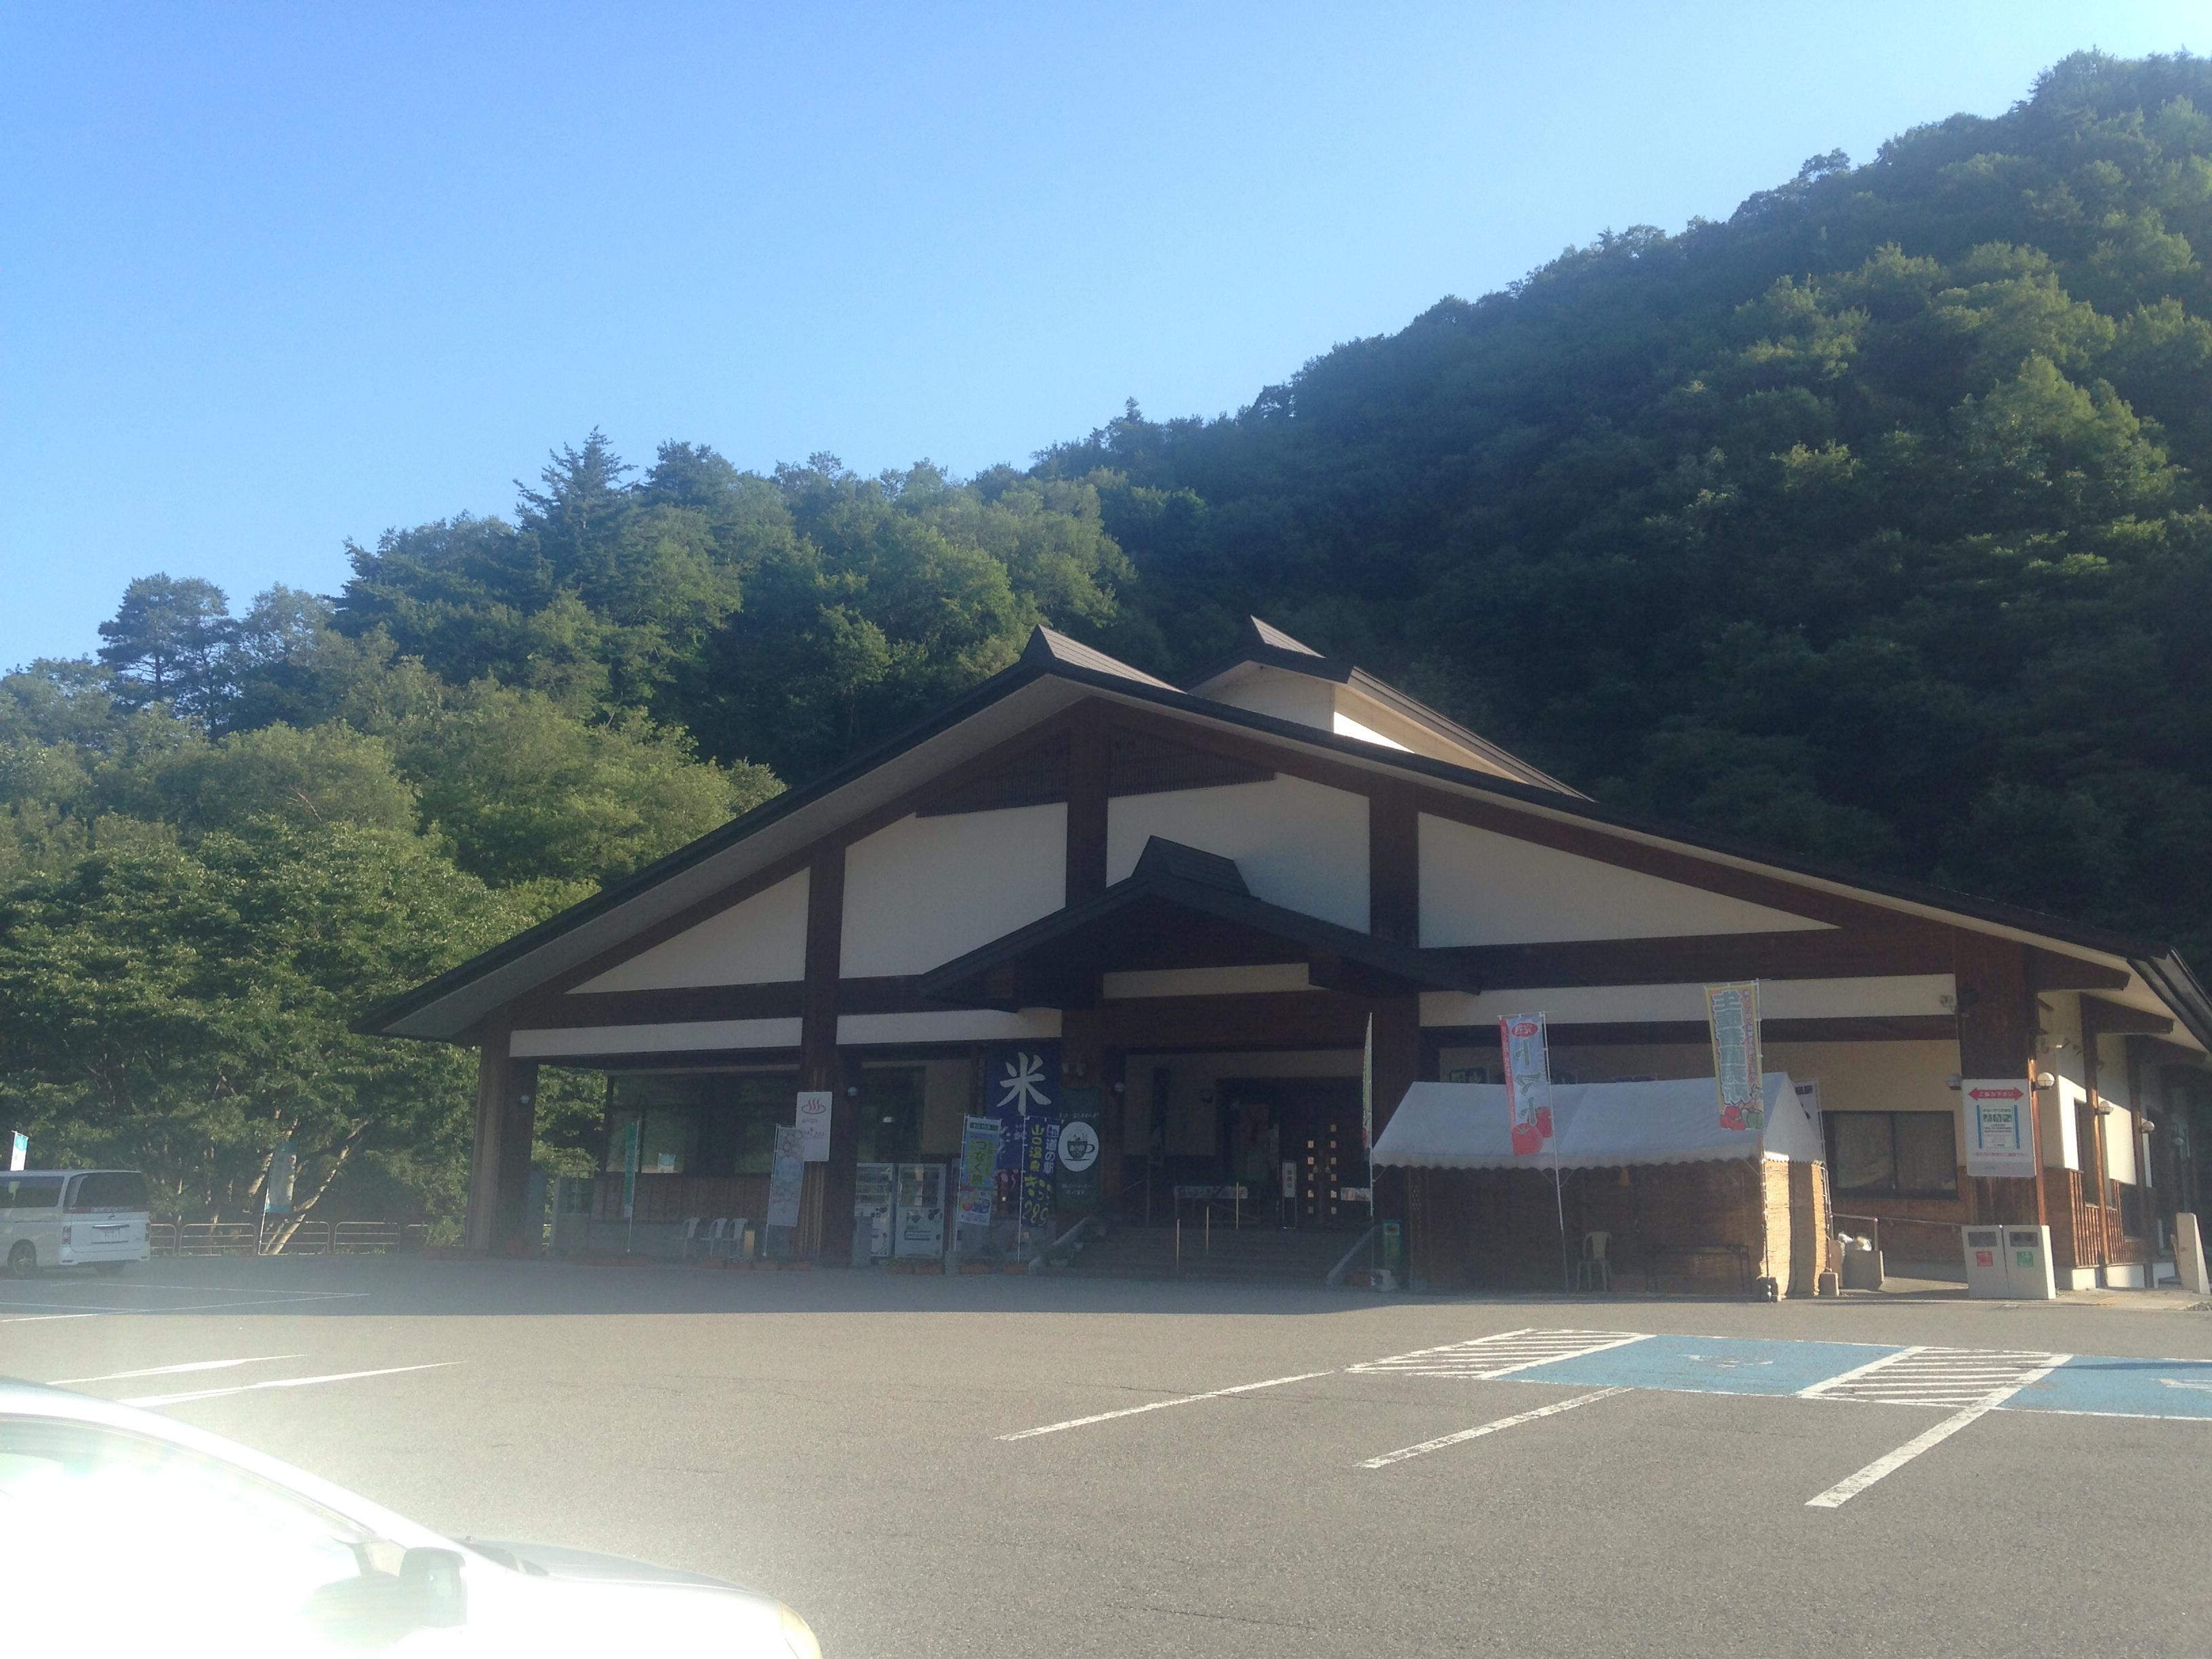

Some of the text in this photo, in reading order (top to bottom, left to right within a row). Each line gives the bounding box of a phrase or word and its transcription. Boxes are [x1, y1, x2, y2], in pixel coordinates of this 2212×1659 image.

[996, 1051, 1052, 1115] 米
[1042, 1138, 1058, 1174] 道の駅
